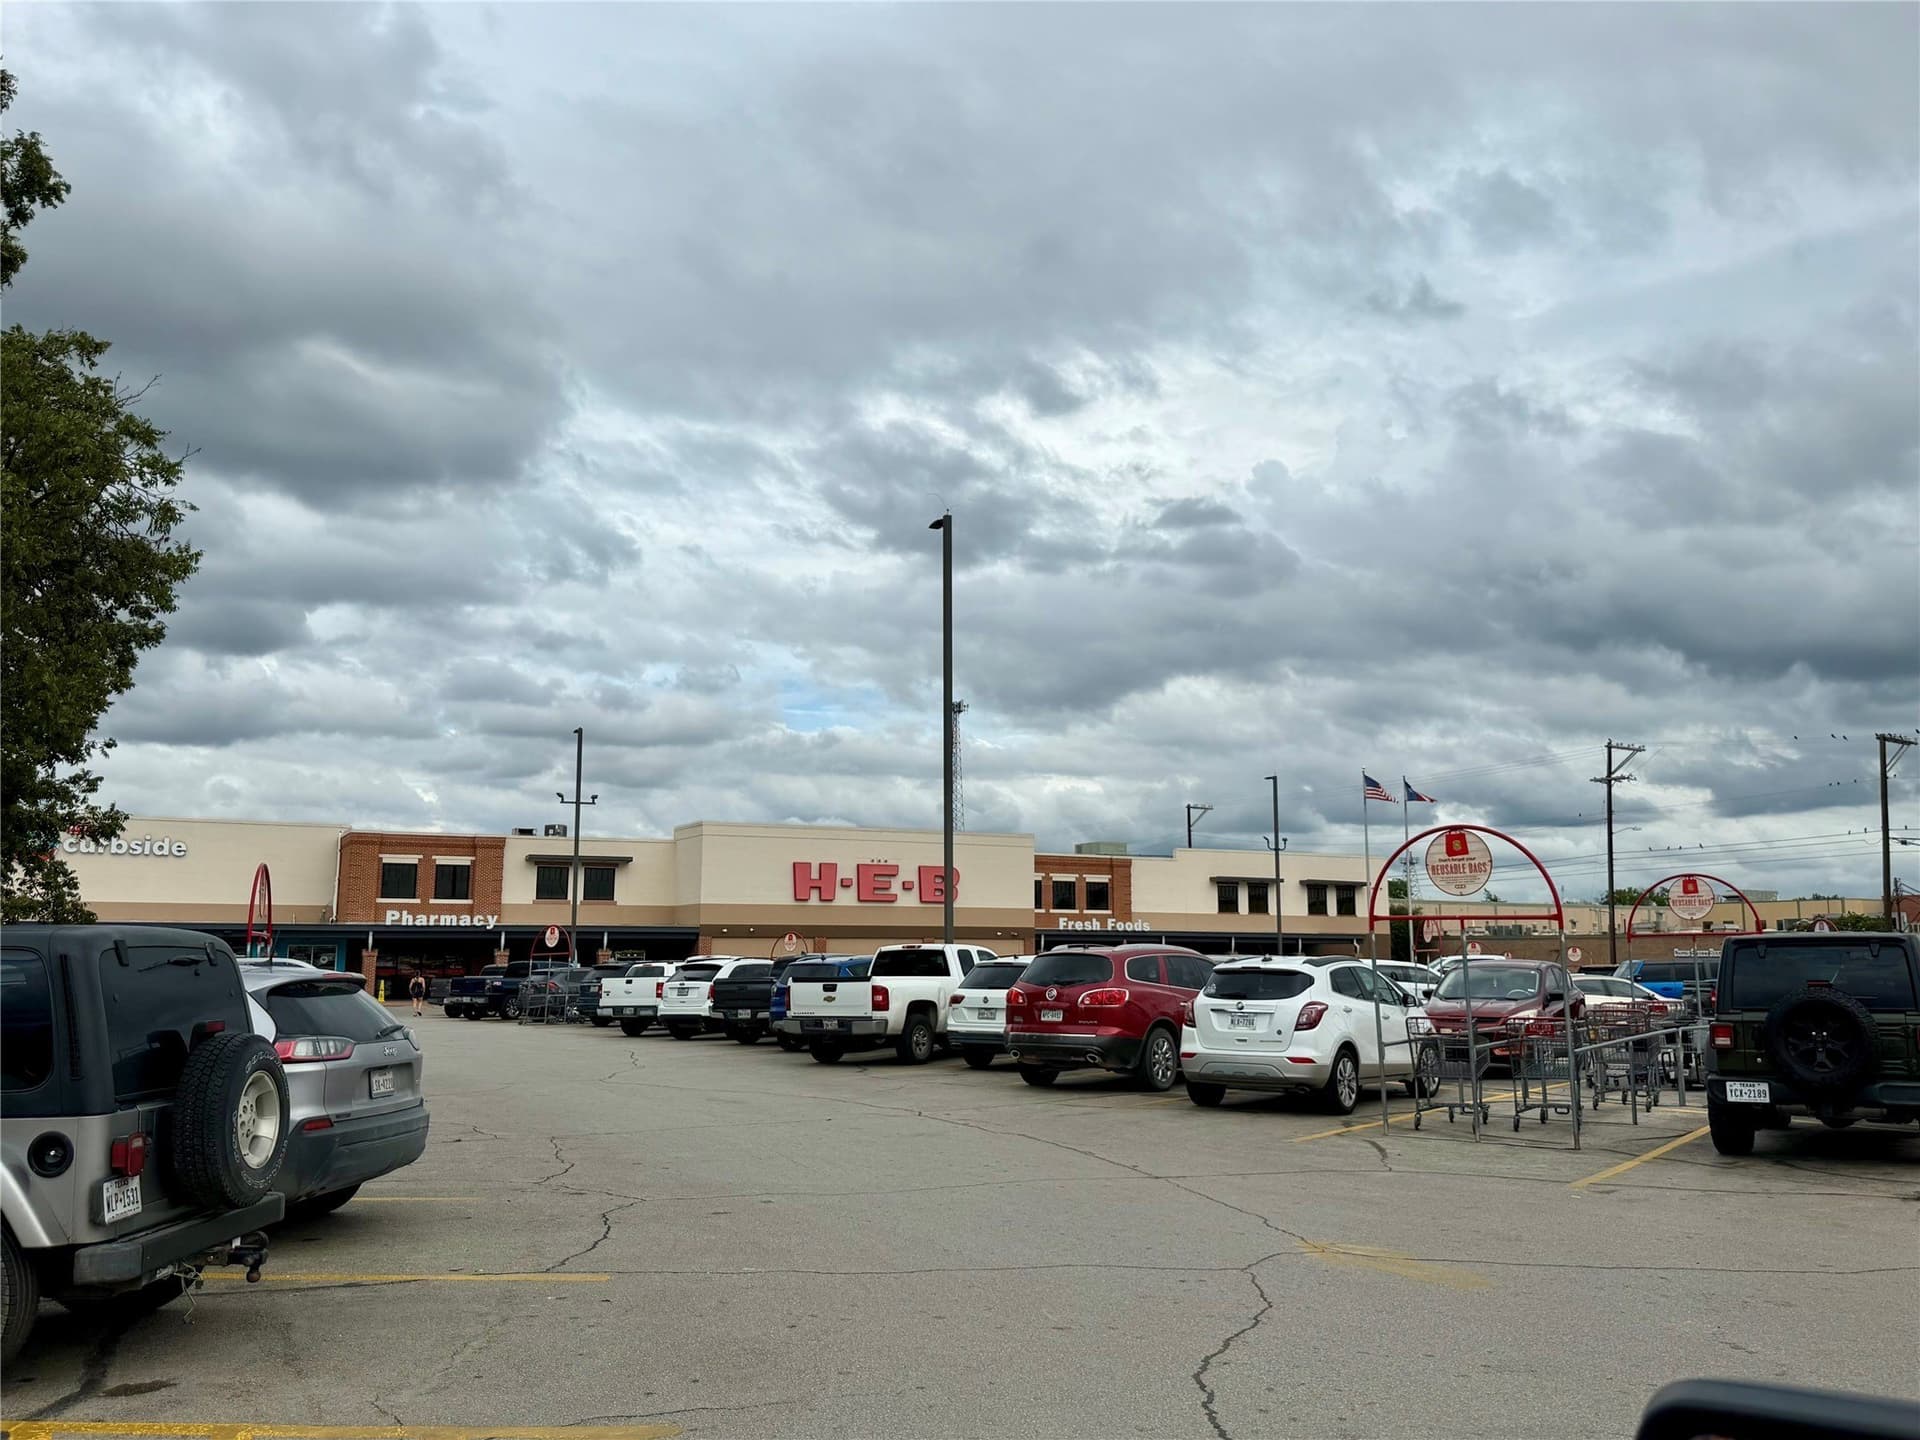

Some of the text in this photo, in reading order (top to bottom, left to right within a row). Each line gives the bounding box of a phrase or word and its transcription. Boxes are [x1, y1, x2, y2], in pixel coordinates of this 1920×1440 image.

[63, 835, 187, 856] curbside
[1431, 861, 1487, 875] REUSABLE BAGS
[793, 862, 960, 904] H-E-B
[385, 910, 498, 929] Pharmacy
[1059, 917, 1150, 931] Fresh Foods
